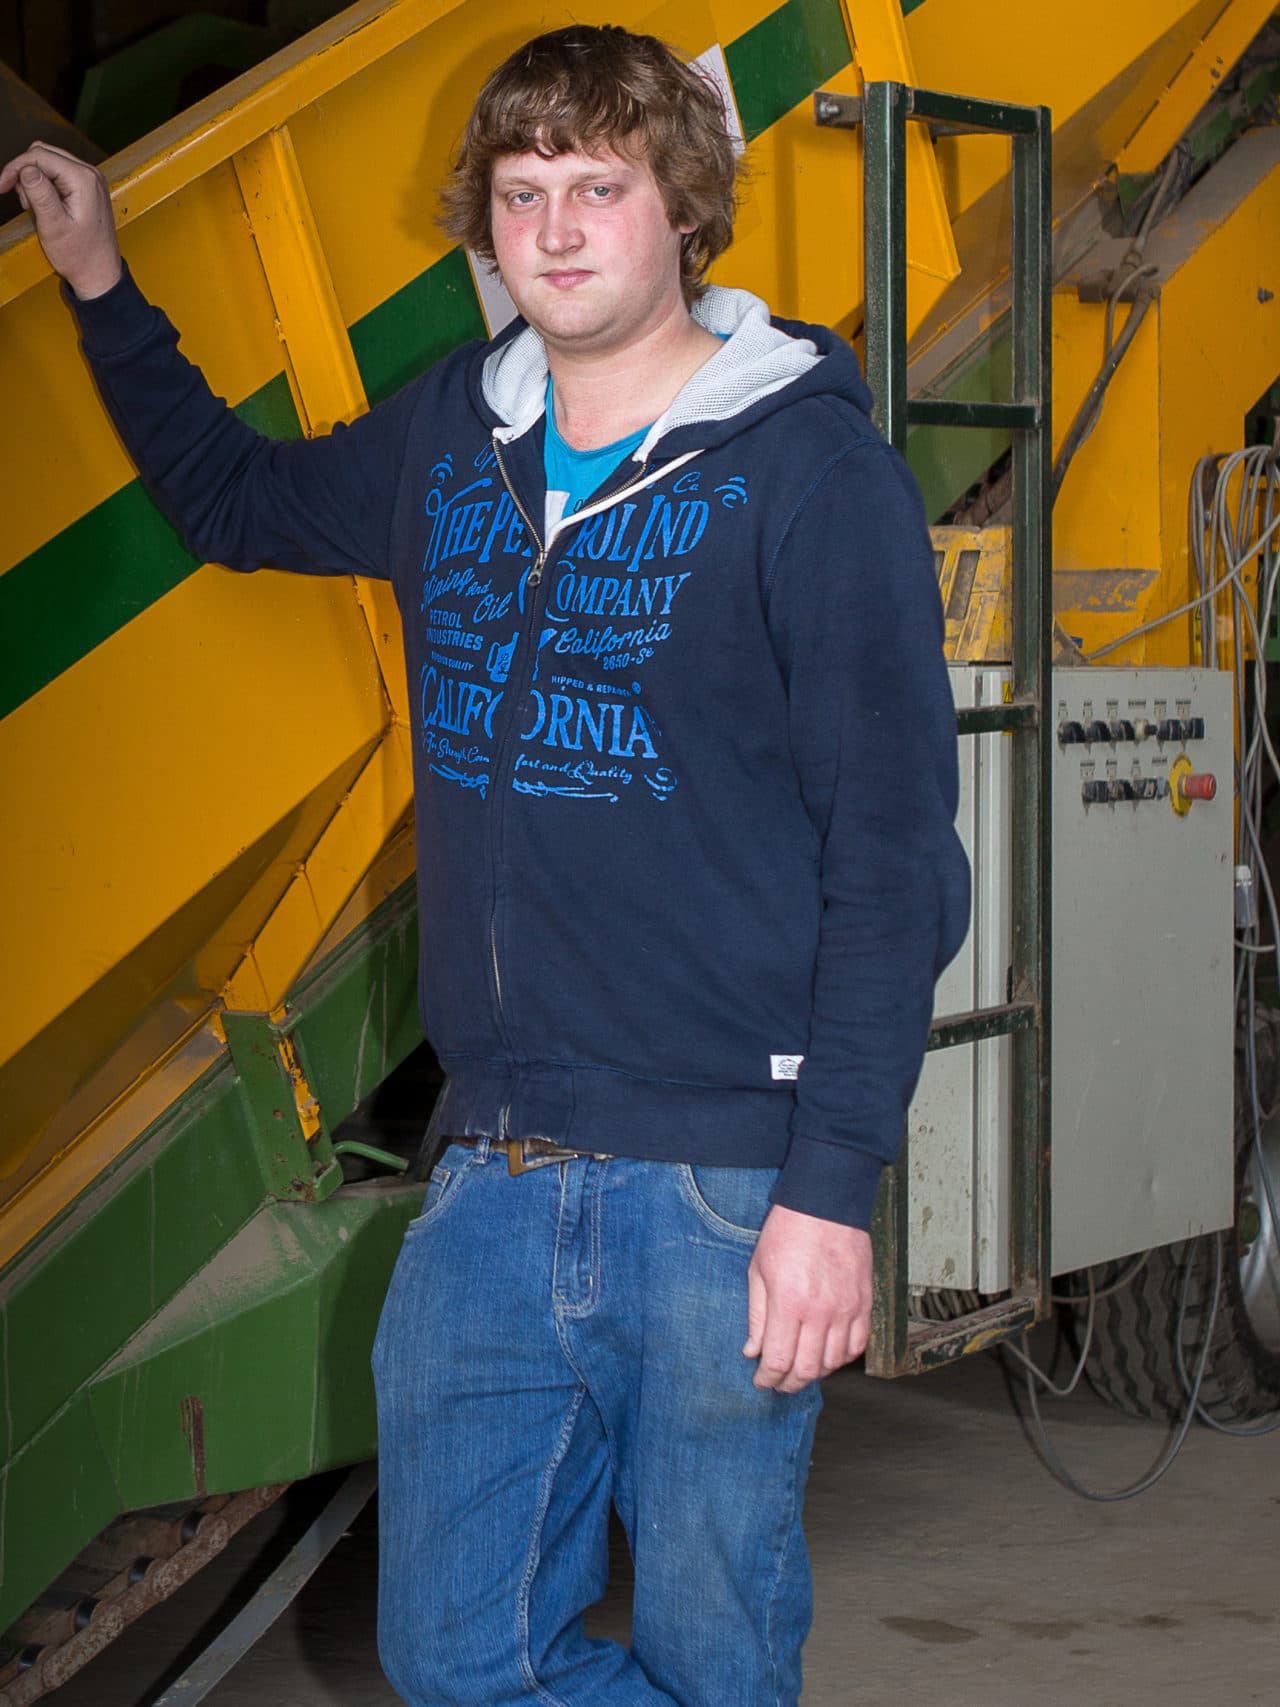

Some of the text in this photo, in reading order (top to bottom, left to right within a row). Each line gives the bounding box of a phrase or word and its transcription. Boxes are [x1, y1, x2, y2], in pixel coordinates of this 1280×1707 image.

[423, 477, 493, 572] THE
[626, 494, 710, 573] IND
[429, 608, 463, 629] PETROL
[472, 591, 513, 624] Oil
[425, 627, 484, 651] INDUSTRIES
[554, 618, 673, 661] California
